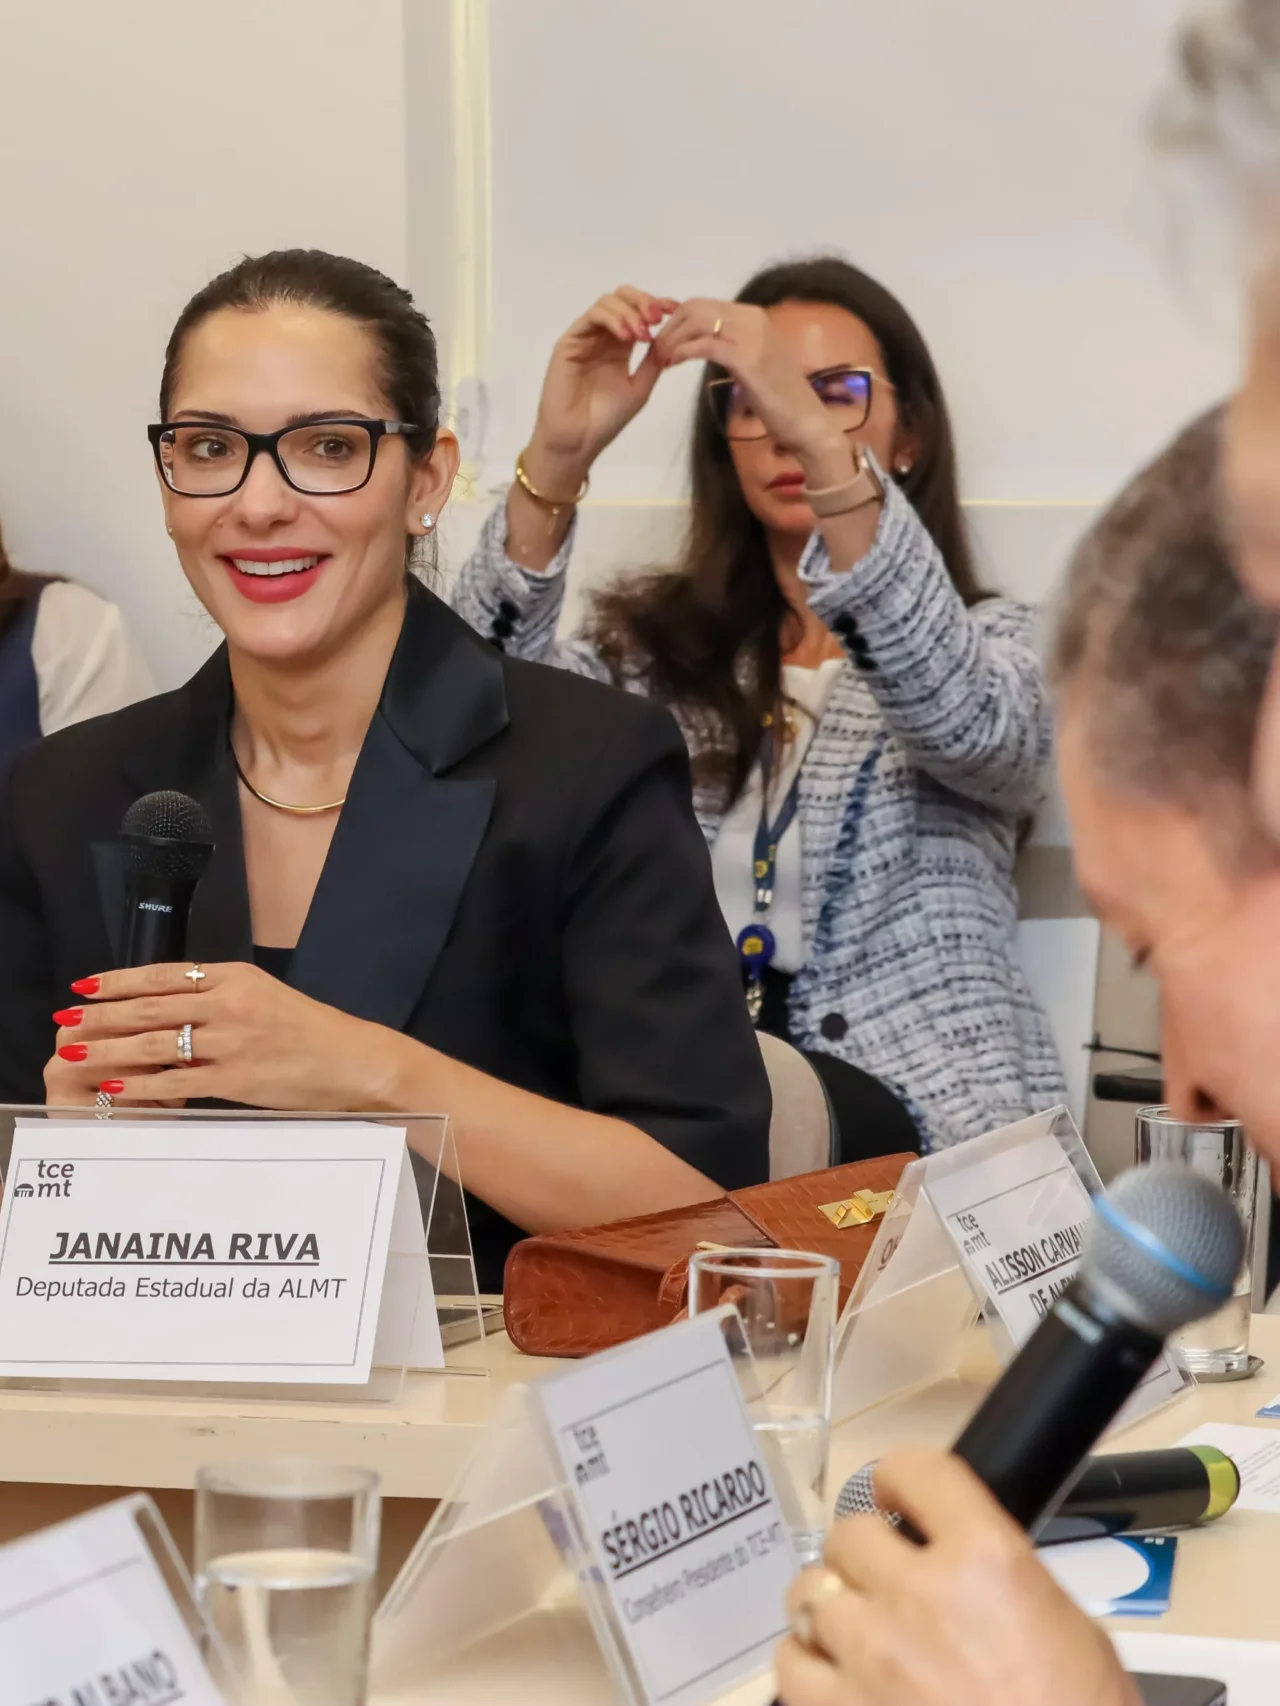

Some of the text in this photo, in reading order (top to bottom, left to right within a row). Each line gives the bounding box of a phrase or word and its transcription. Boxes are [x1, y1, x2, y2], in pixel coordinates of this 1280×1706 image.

[138, 902, 174, 913] SHURE
[37, 1160, 74, 1179] tce
[37, 1179, 72, 1198] mt
[956, 1213, 979, 1233] tce
[49, 1232, 321, 1261] JANAINA RIVA
[971, 1229, 991, 1251] mt
[985, 1242, 1046, 1290] ALISSON
[16, 1276, 347, 1301] Deputada Estadual da ALMT
[601, 1460, 767, 1570] SÉRGIO RICARDO
